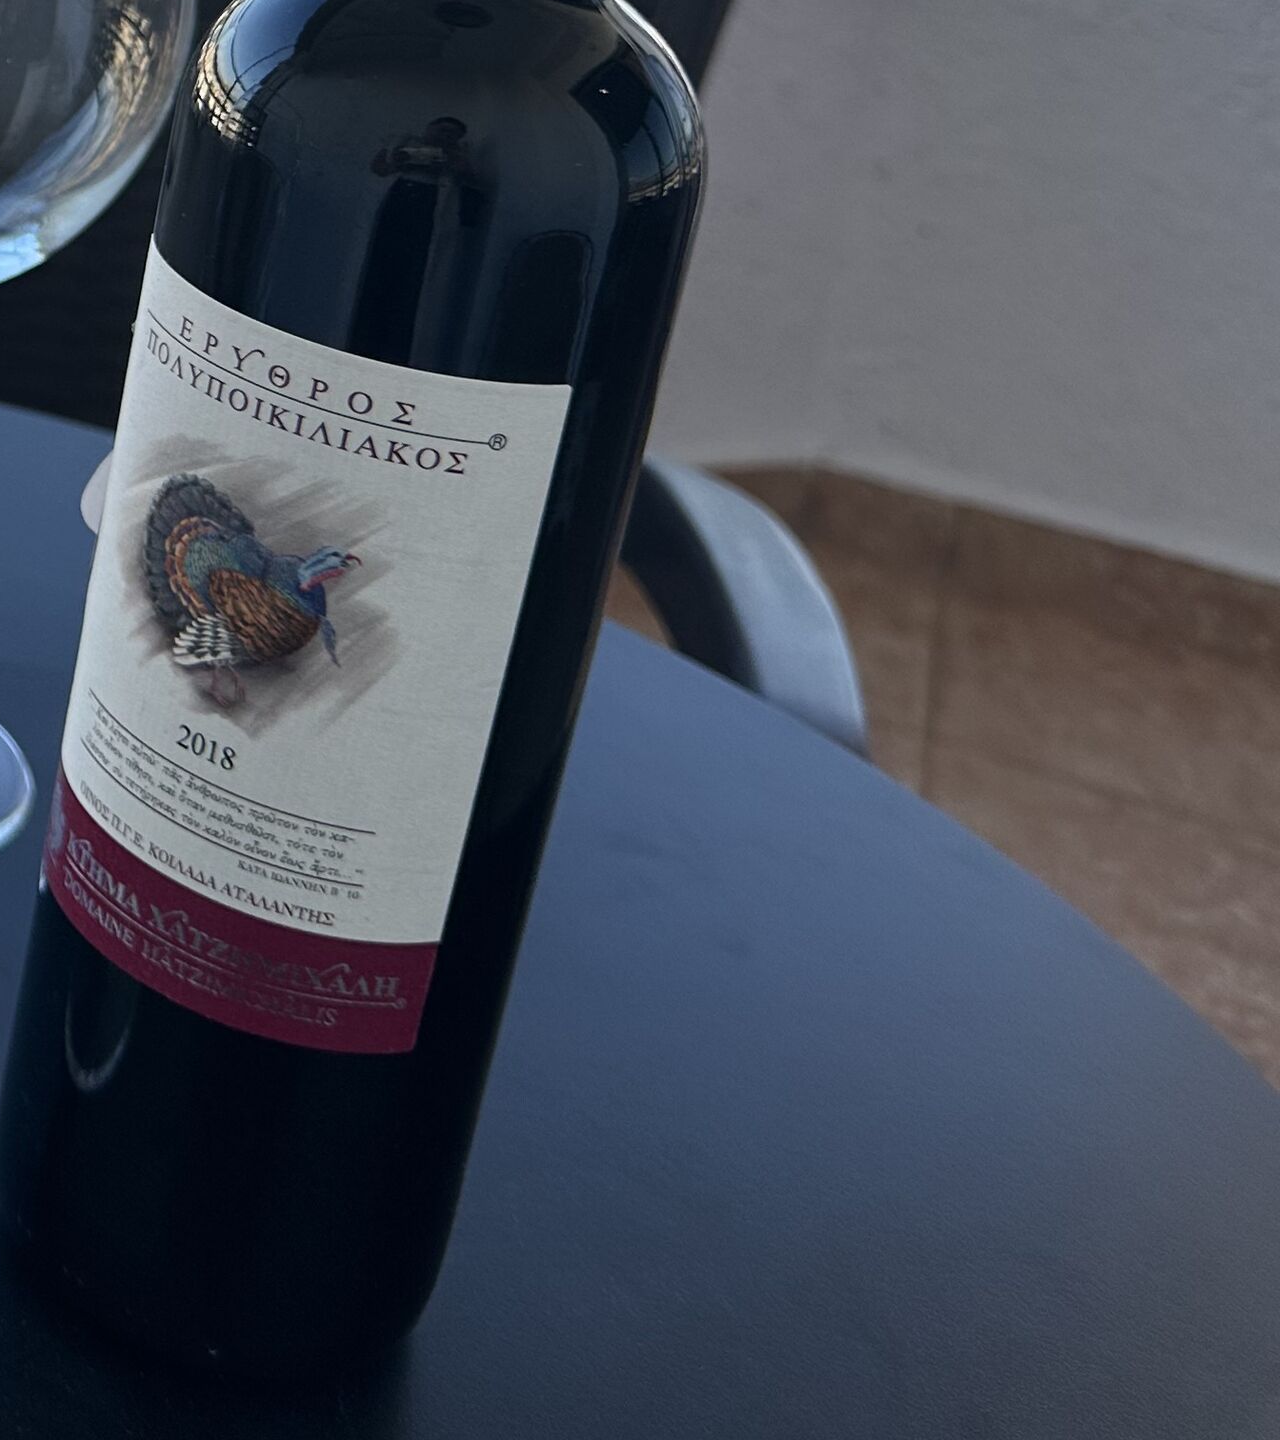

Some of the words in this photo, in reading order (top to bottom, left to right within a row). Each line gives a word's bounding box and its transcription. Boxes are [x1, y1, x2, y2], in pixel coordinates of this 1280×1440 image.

[146, 327, 469, 475] ΠΟΛΥΠΟΙΚΙΛΙΑΚΟΣ
[175, 723, 237, 771] 2018
[62, 865, 136, 948] DOMAINE
[148, 841, 217, 890] ΚΟΙΛΑΔΑ
[220, 882, 336, 927] ΑΤΑΛΑΝΤΗΣ
